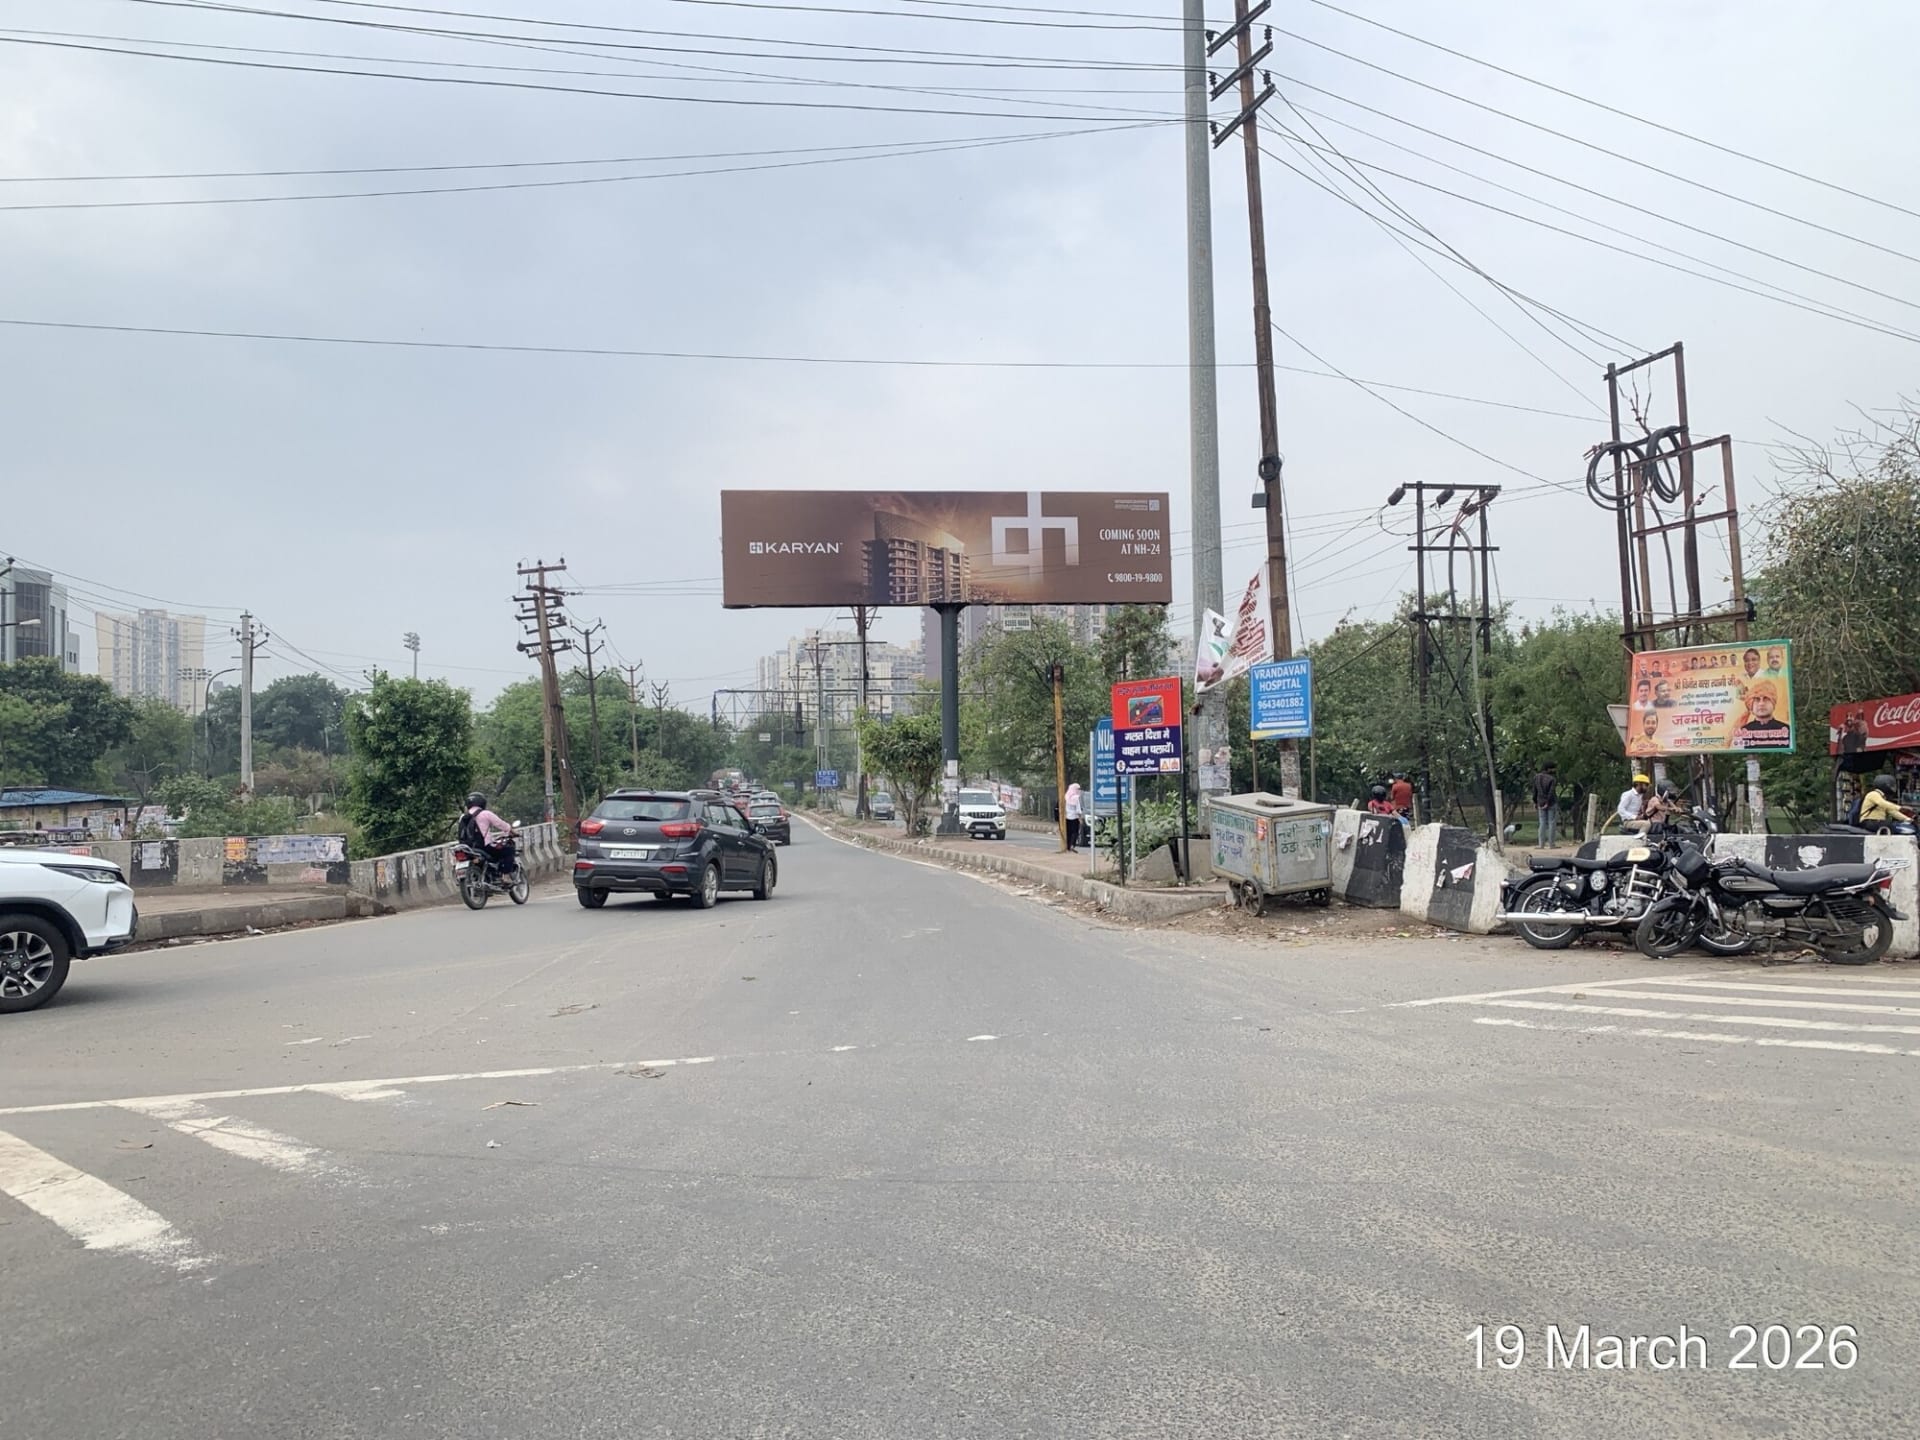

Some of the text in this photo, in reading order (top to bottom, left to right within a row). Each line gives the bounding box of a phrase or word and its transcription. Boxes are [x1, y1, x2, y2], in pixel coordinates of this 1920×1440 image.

[1100, 529, 1160, 541] COMING SOON
[765, 542, 839, 554] KARYAN
[1121, 544, 1160, 555] AT NH-24
[1253, 663, 1307, 680] VRANDAVAN
[1259, 677, 1302, 692] HOSPITAL
